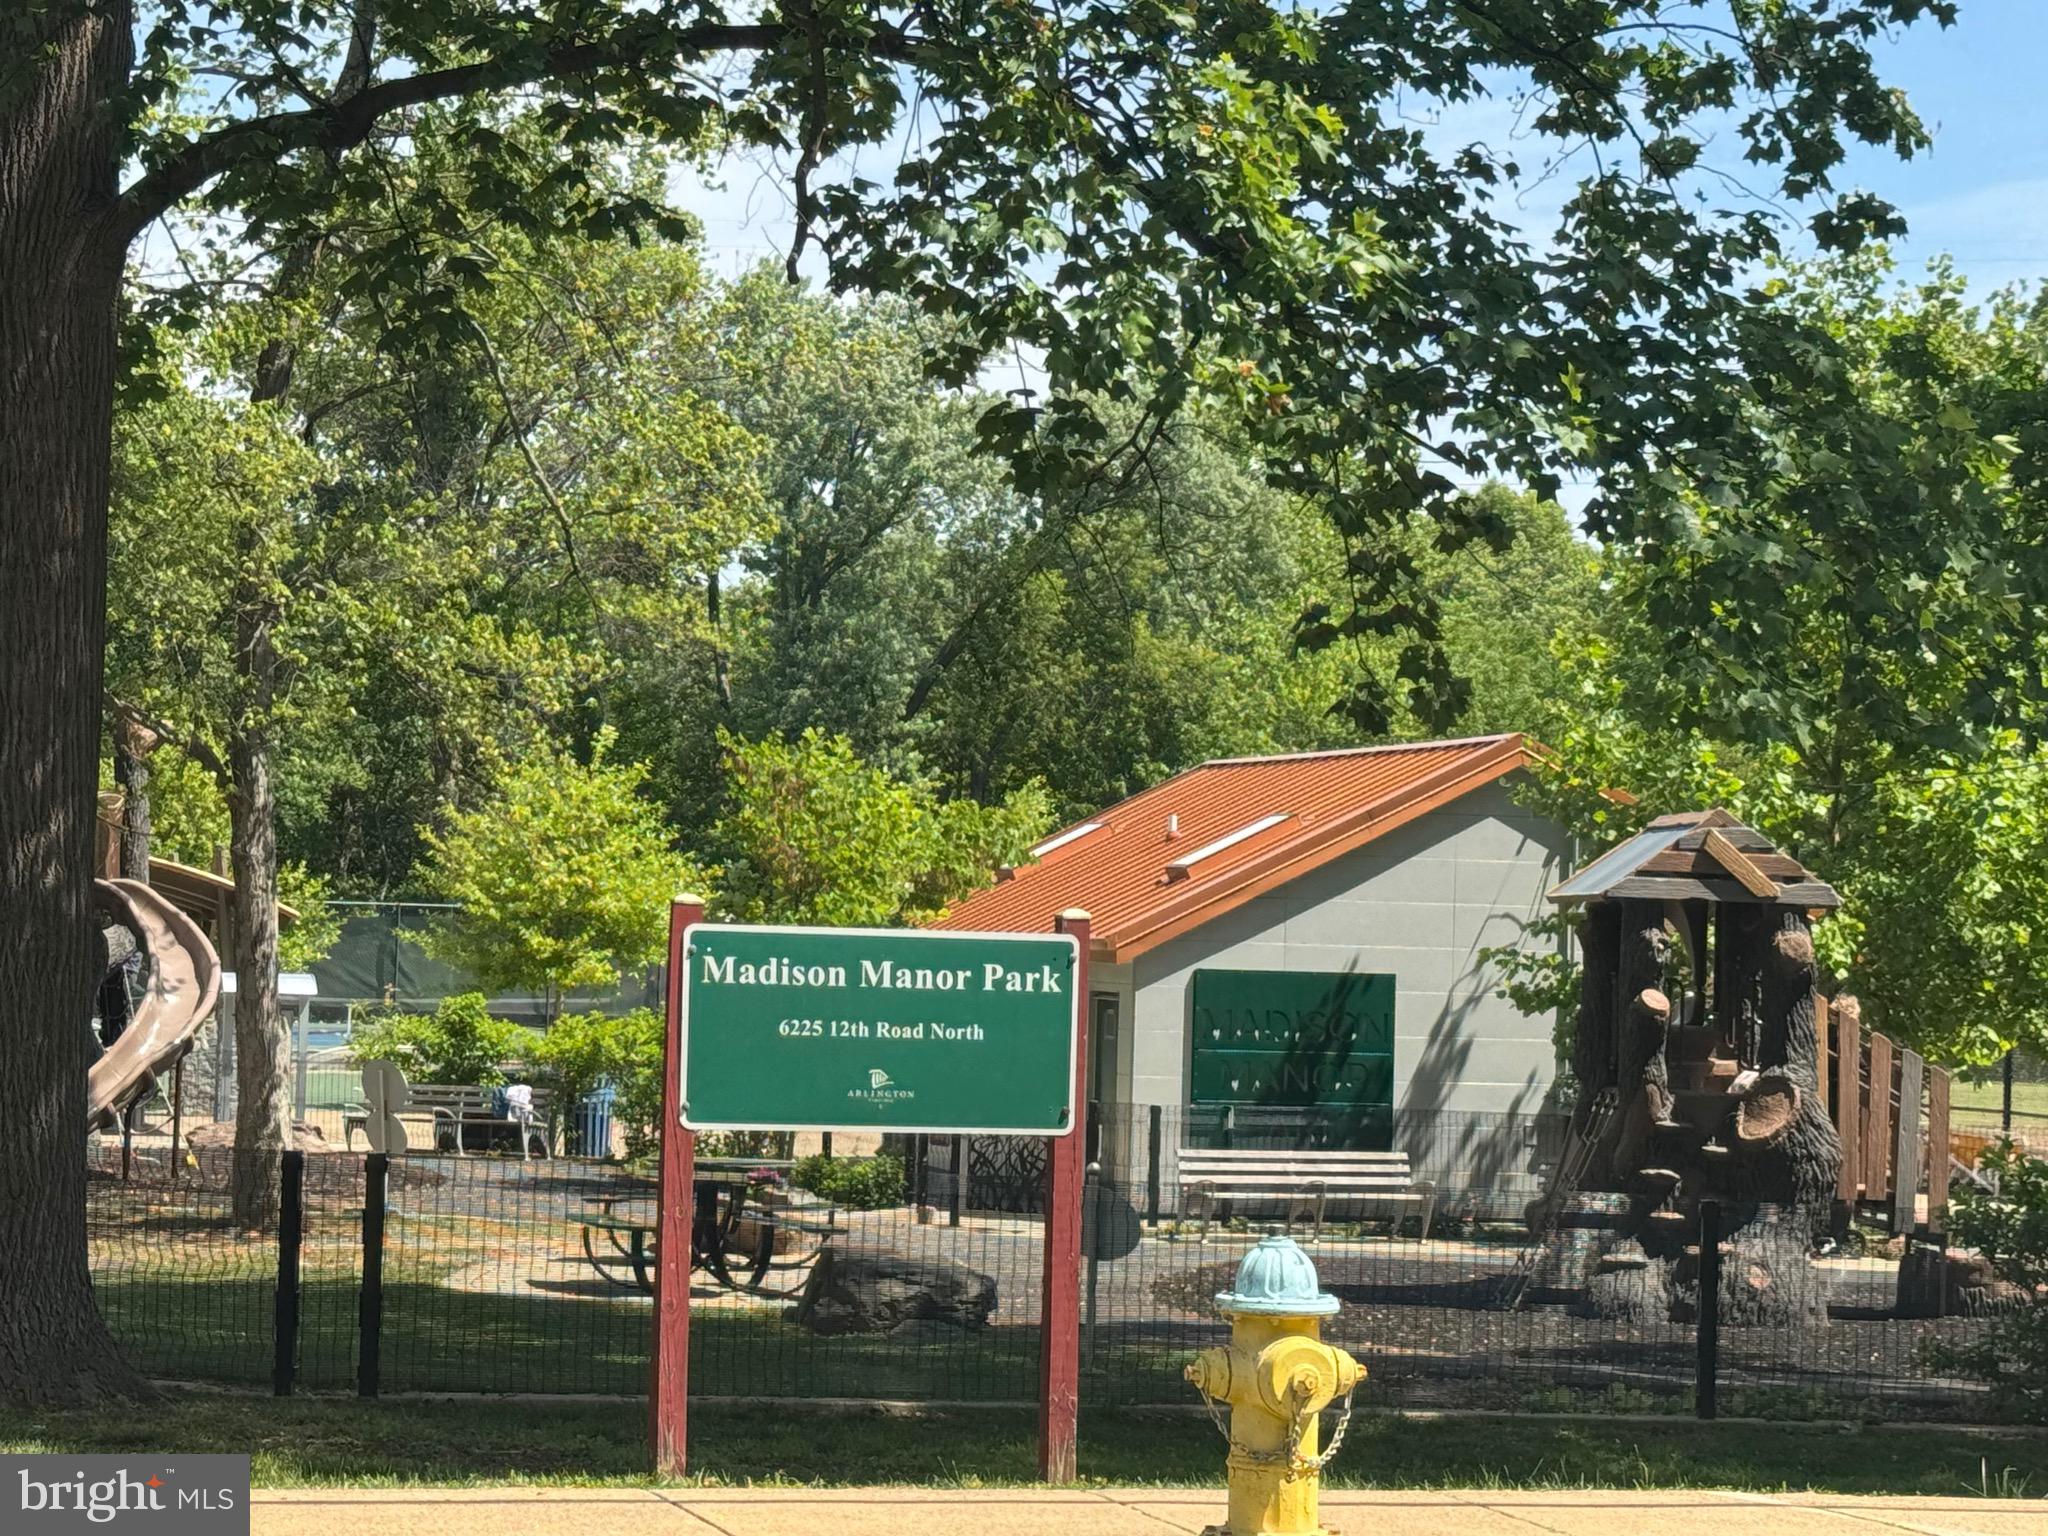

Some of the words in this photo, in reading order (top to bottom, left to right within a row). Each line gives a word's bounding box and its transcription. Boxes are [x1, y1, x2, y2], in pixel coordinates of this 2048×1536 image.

[701, 955, 847, 988] Madison
[859, 959, 972, 991] Manor
[983, 963, 1063, 993] Park
[778, 1019, 823, 1037] 6225
[830, 1020, 870, 1038] 12th
[876, 1021, 924, 1040] Road
[930, 1022, 985, 1041] North
[1200, 1007, 1390, 1044] MADISON
[847, 1089, 915, 1098] ARLINGTON
